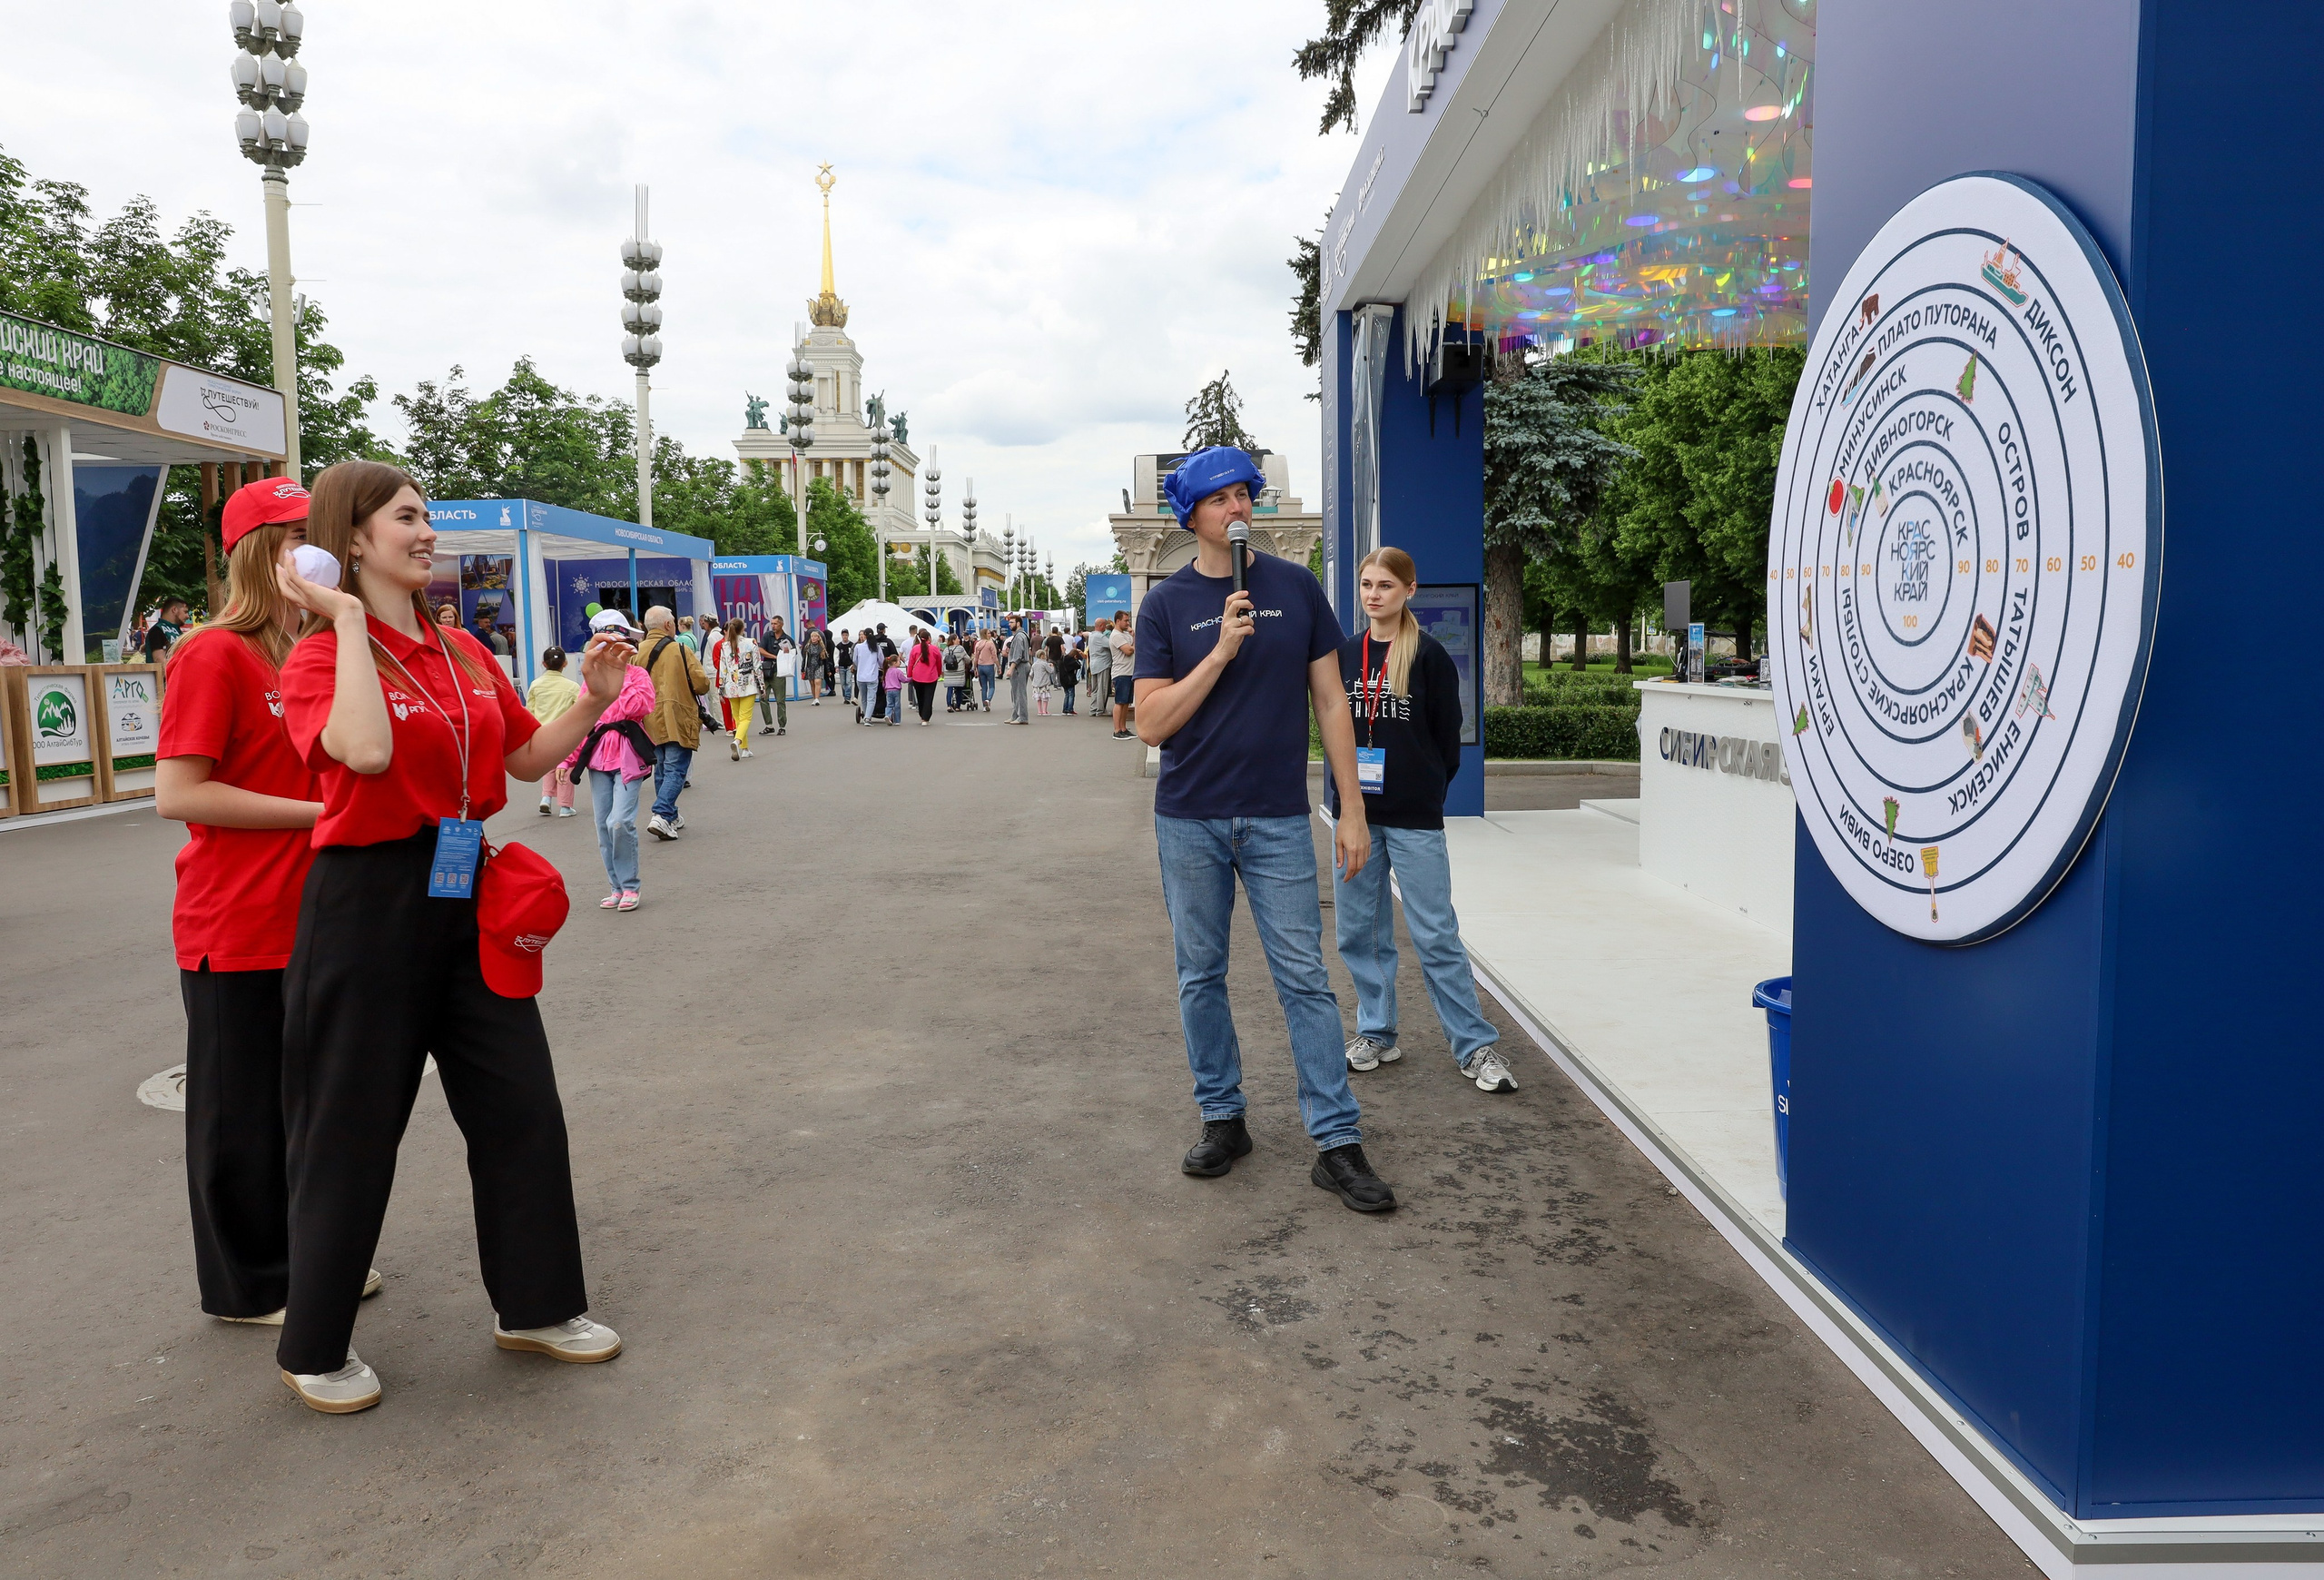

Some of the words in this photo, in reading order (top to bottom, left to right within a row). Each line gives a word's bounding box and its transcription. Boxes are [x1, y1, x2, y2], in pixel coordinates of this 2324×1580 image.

[1877, 310, 1922, 357] ПЛАТО
[1924, 303, 1998, 351] ПУТОРАНА
[62, 338, 103, 375] КРАЙ
[2024, 299, 2077, 404] ДИКСОН
[7, 362, 82, 393] настоящее!
[1816, 325, 1859, 416] ХАТАНГА
[207, 389, 260, 410] ПУТЕШЕСТВУЙ!
[210, 423, 247, 438] РОСКОНГРЕСС
[1838, 364, 1908, 479] МИНУСИНСК
[1864, 410, 1955, 484] ДИВНОГОРСК
[1998, 421, 2030, 541] ОСТРОВ
[428, 509, 477, 520] БЛАСТЬ
[1888, 460, 1969, 548] КРАСНОЯРСК
[1897, 519, 1931, 541] КРАС
[1891, 540, 1935, 561] НОЯРС
[2117, 552, 2135, 569] 40
[1786, 568, 1795, 579] 50
[1803, 567, 1812, 578] 60
[1822, 566, 1830, 577] 70
[1840, 565, 1850, 576] 80
[1861, 564, 1871, 575] 90
[1902, 559, 1928, 581] КИЙ
[1957, 559, 1970, 574] 90
[1985, 558, 1999, 573] 80
[2015, 558, 2029, 573] 70
[2046, 557, 2062, 572] 60
[2080, 555, 2096, 571] 50
[595, 579, 664, 588] НОВОСИИРСКАЯ
[1770, 569, 1778, 580] 40
[1894, 580, 1928, 602] КРАЙ
[1259, 609, 1283, 617] КРАЙ
[1903, 615, 1917, 627] 100
[1842, 588, 1870, 676] СТОЛБЫ
[1979, 588, 2027, 723] ТАТЫШЕВ
[1809, 654, 1835, 737] ЕРГАКИ
[1868, 656, 1974, 726] КРАСНОЯРСКИЕ
[33, 740, 45, 749] ООО
[46, 738, 83, 748] АлтайСибТур
[1659, 726, 1779, 782] СИБИРСКАЯ
[1949, 719, 2022, 815] ЕНИСЕЙСК
[1839, 804, 1870, 858] ВИВИ
[1873, 842, 1915, 874] ОЗЕРО
